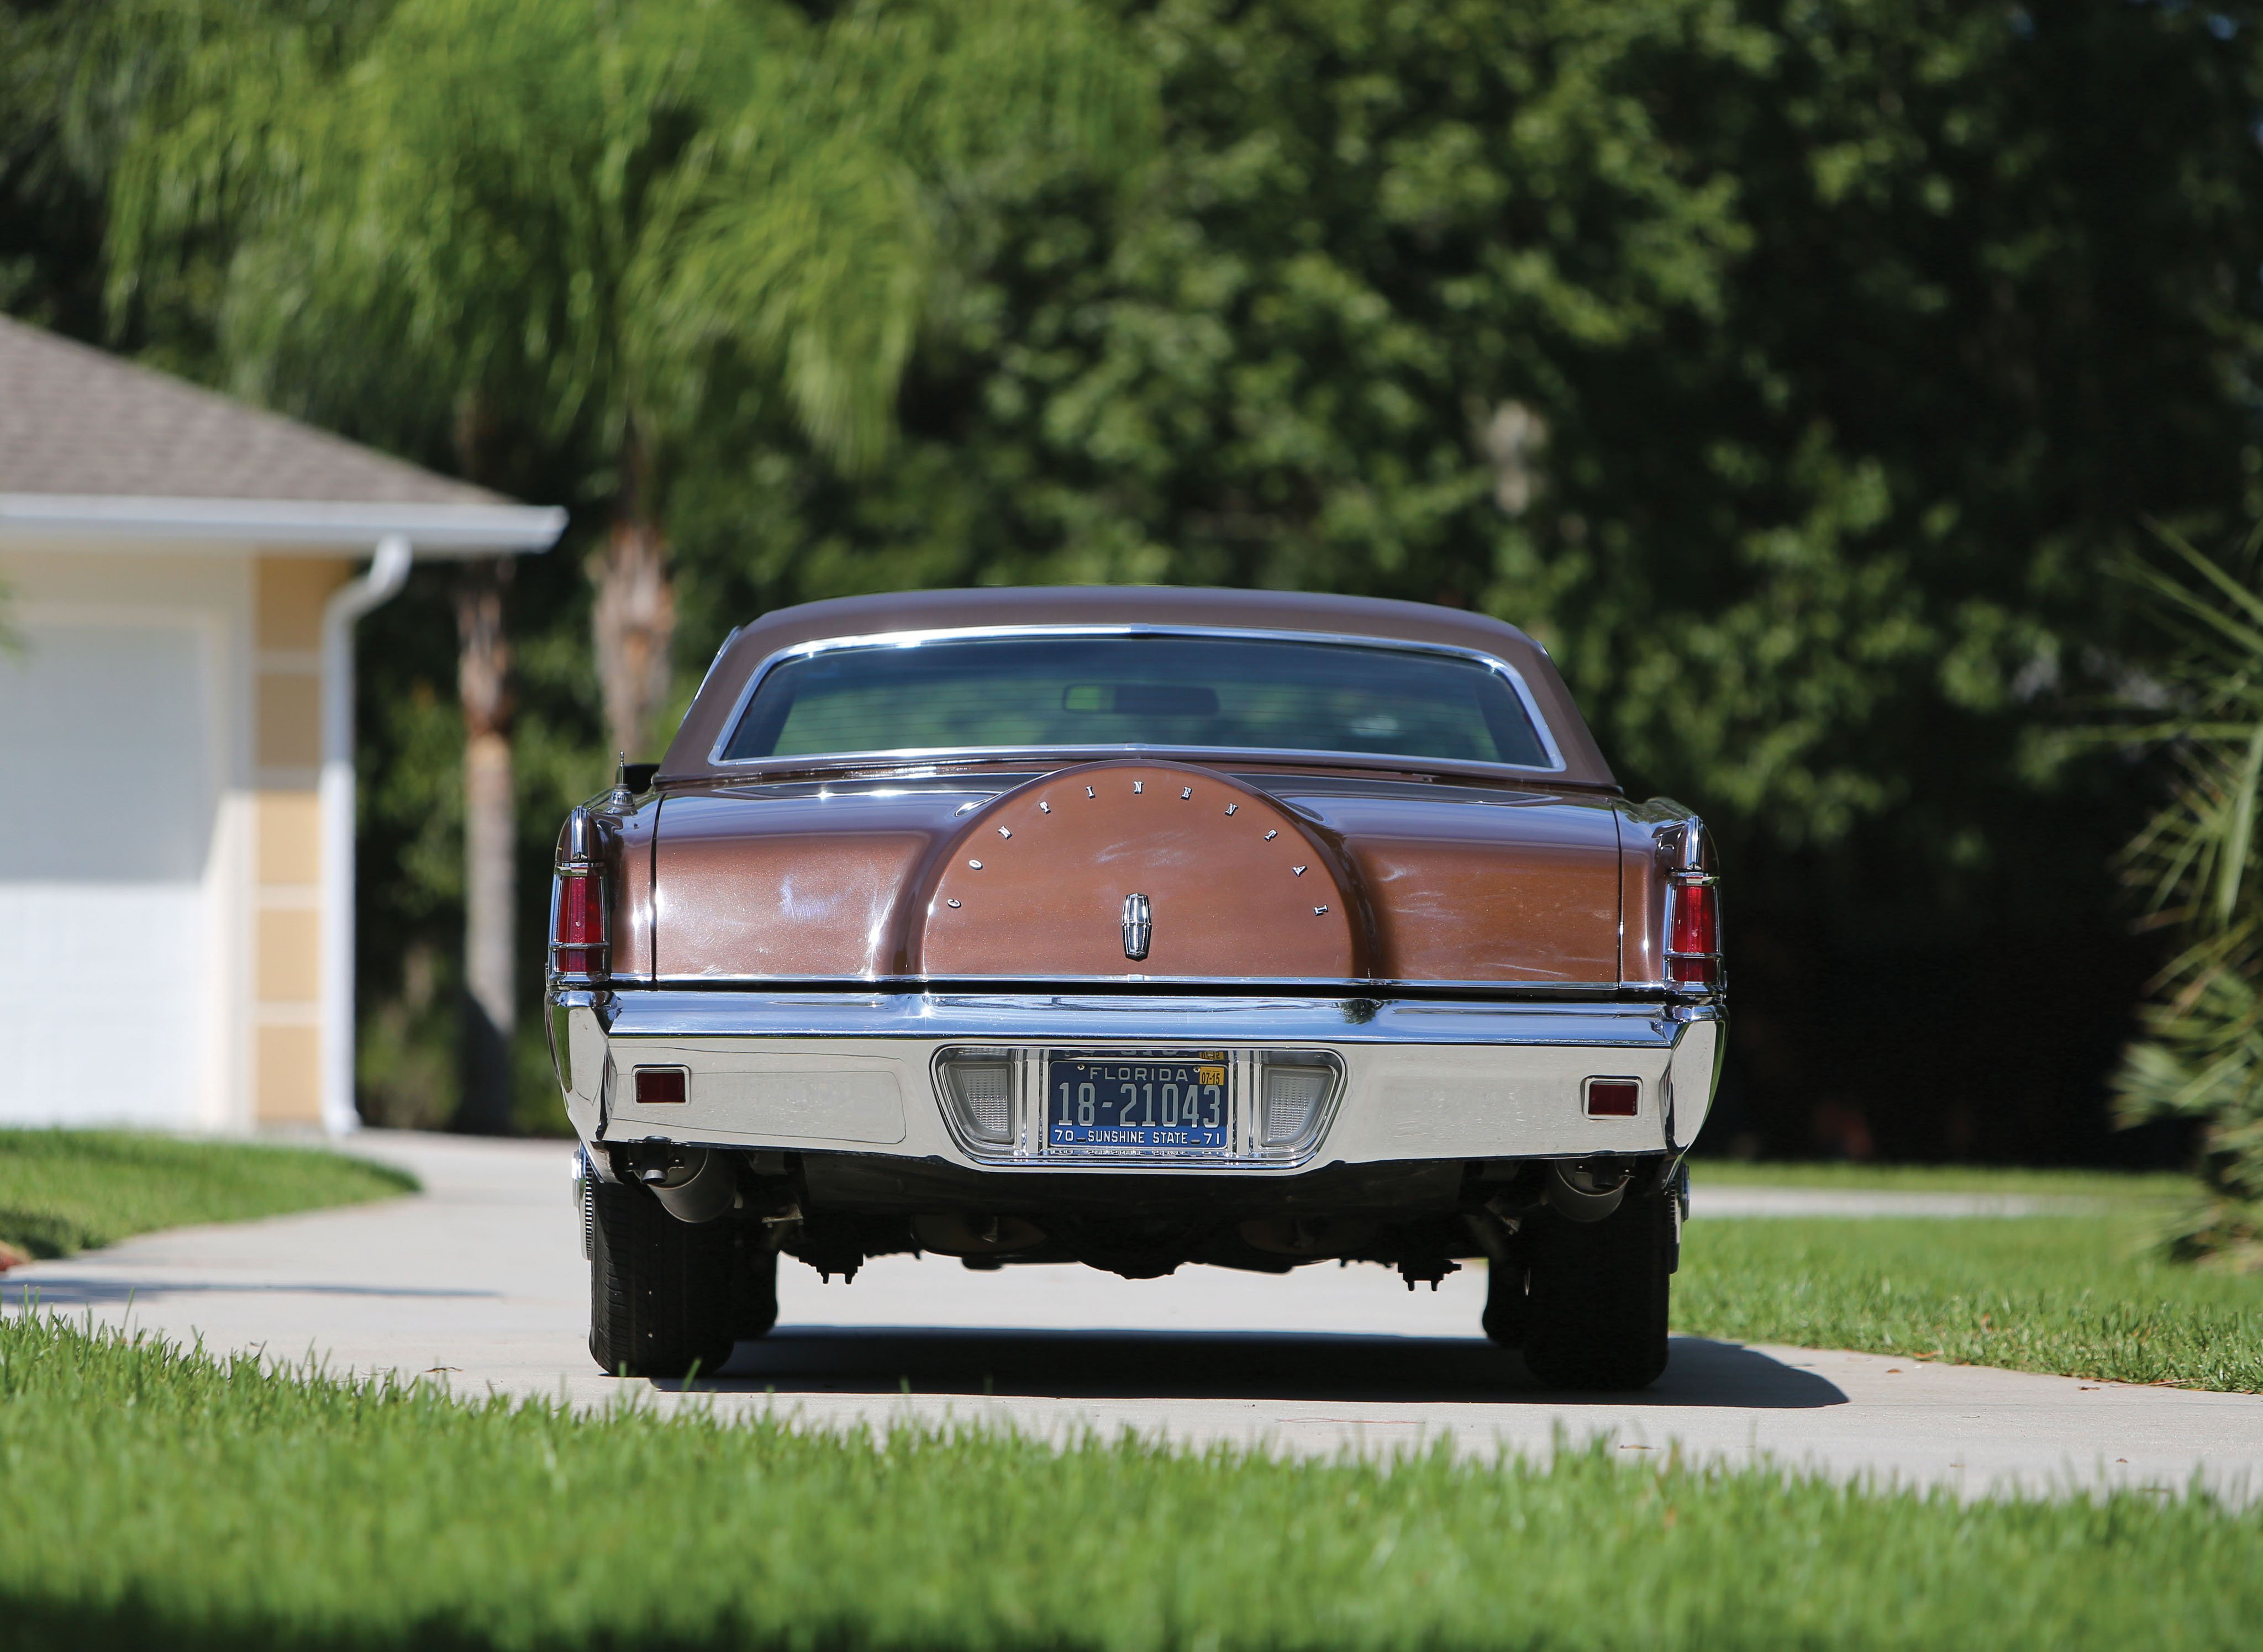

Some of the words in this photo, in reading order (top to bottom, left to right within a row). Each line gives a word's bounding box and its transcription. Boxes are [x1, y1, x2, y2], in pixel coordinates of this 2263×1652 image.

[946, 780, 1329, 916] CONTINENTAL
[1090, 1067, 1188, 1081] FLORIDA
[1201, 1072, 1220, 1085] 07-15
[1058, 1082, 1221, 1128] 18-21043
[1054, 1129, 1074, 1142] 70
[1088, 1130, 1145, 1143] SUNSHINE
[1152, 1131, 1188, 1144] STATE
[1203, 1132, 1220, 1144] 71
